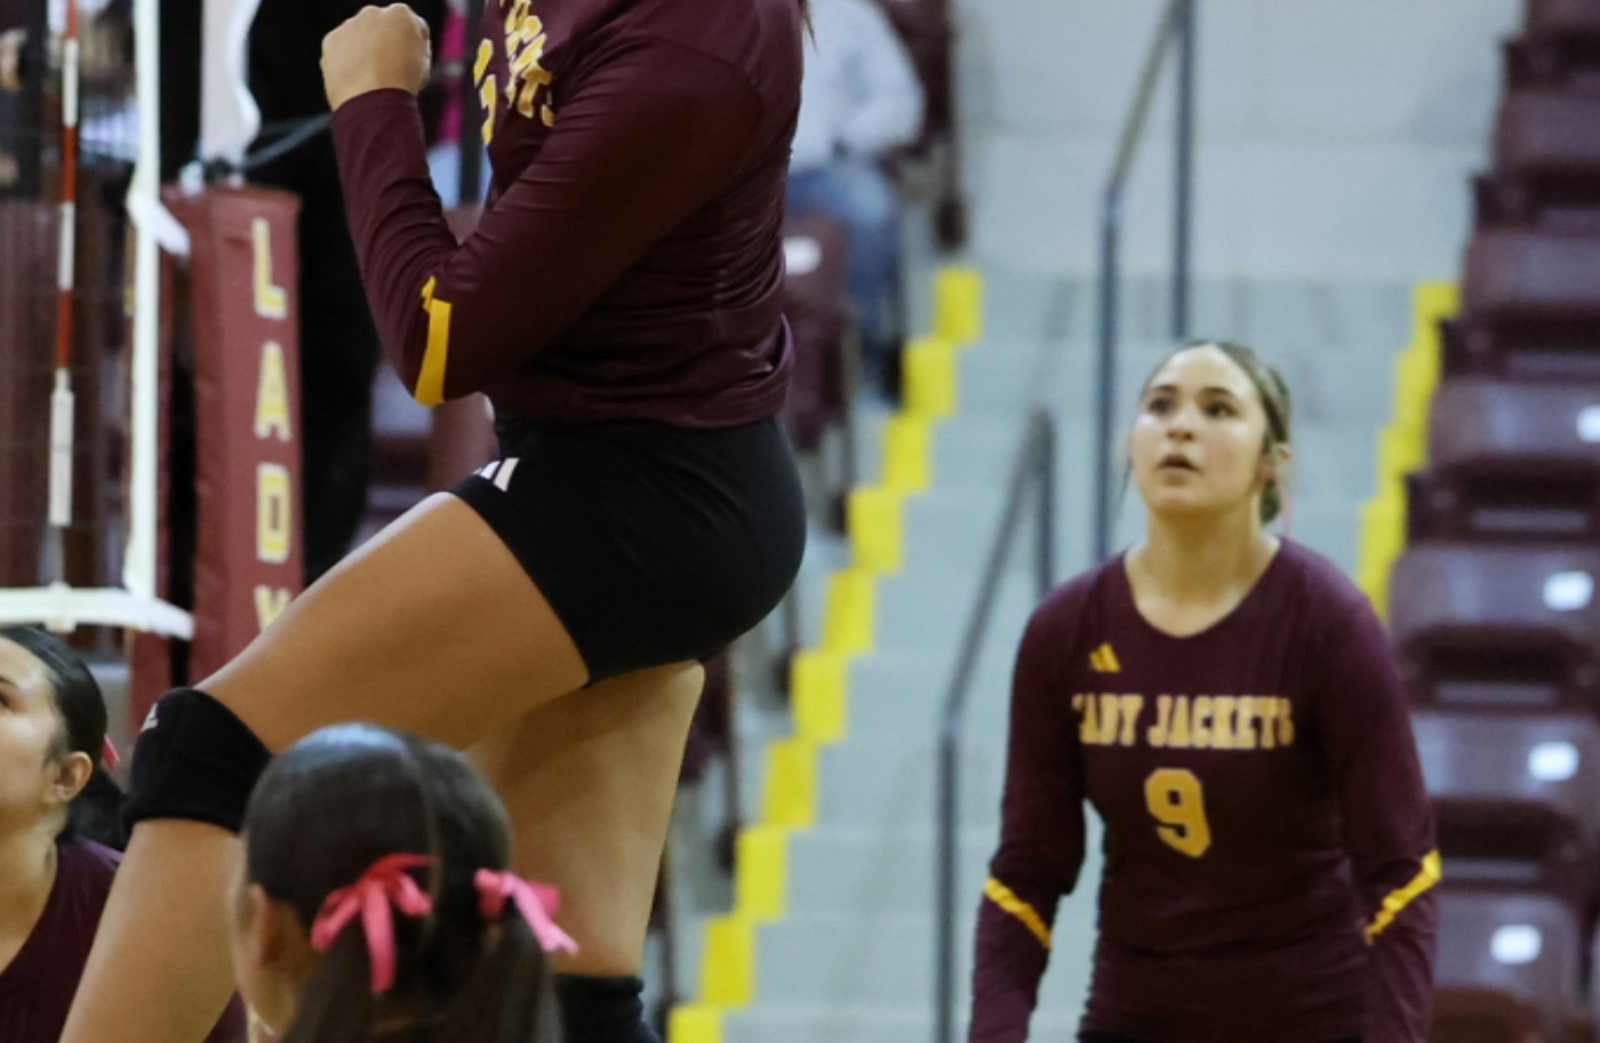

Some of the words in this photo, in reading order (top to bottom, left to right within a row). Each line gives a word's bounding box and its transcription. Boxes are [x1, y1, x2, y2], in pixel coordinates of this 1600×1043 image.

[1071, 693, 1145, 747] ADY
[1147, 694, 1294, 749] JACKETS
[1144, 767, 1211, 858] 9
